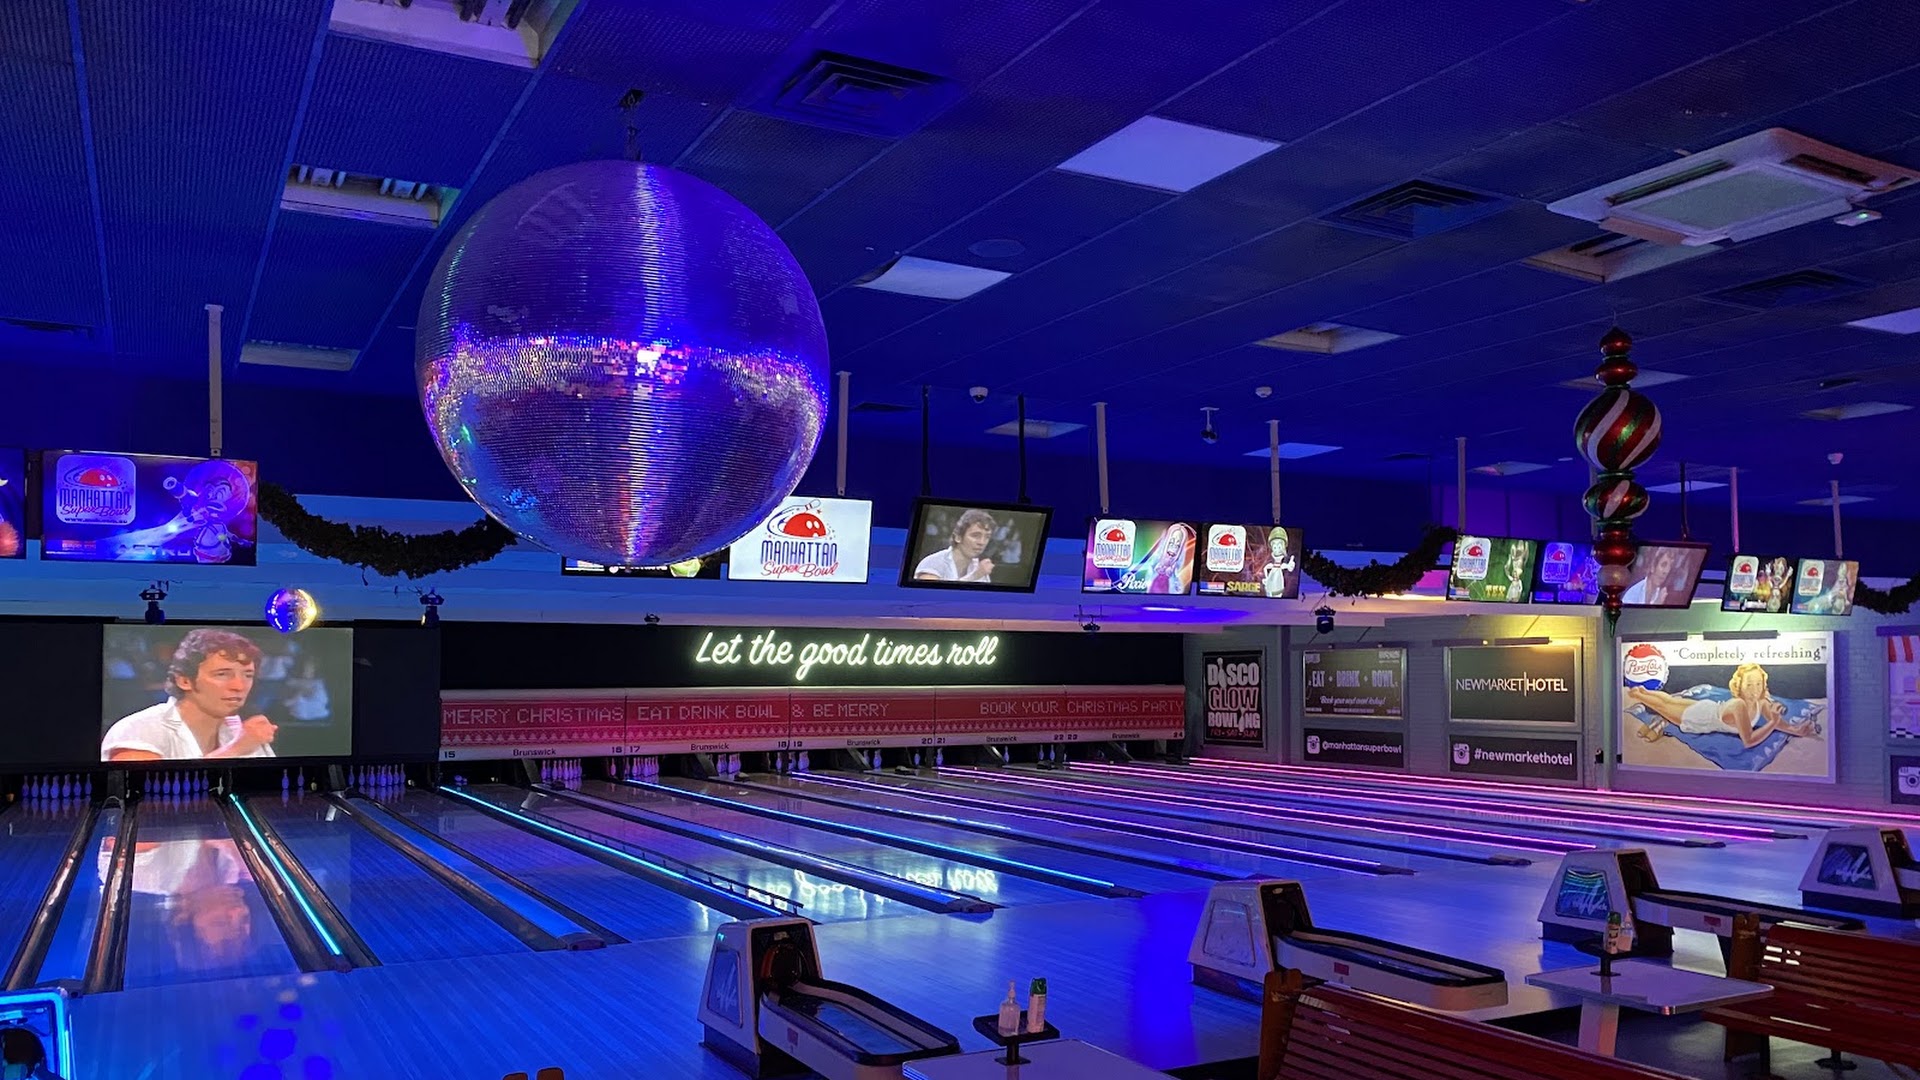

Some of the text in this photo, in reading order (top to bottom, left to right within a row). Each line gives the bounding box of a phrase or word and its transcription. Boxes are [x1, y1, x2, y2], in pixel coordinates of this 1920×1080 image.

[60, 488, 130, 507] MANHATTAN
[61, 503, 131, 516] Super Bowl
[761, 540, 838, 566] MANHATTAN
[761, 561, 839, 578] Super Bowl
[696, 629, 999, 681] Let the good times roll
[1207, 659, 1260, 688] DISCO
[1312, 670, 1325, 687] EAT
[1456, 678, 1568, 692] NEWMARKET HOTEL
[1208, 686, 1260, 712] GLOW
[443, 703, 890, 725] MERRY CHRISTMAS EAT DRINK BOWL & BE MERRY
[980, 700, 1184, 715] BOOK YOUR CHRISTMAS PARTY
[1207, 711, 1261, 730] BOWLING
[846, 738, 881, 746] Brunswick
[921, 737, 933, 745] 20
[986, 735, 1017, 743] Brunswick
[1054, 733, 1065, 741] 22
[1111, 731, 1140, 739] Brunswick
[512, 748, 556, 757] Brunswick
[629, 745, 641, 753] 17
[690, 742, 730, 751] Brunswick
[1322, 740, 1402, 754] @manhattansuperbowl
[1474, 748, 1573, 766] #newmarkethotel
